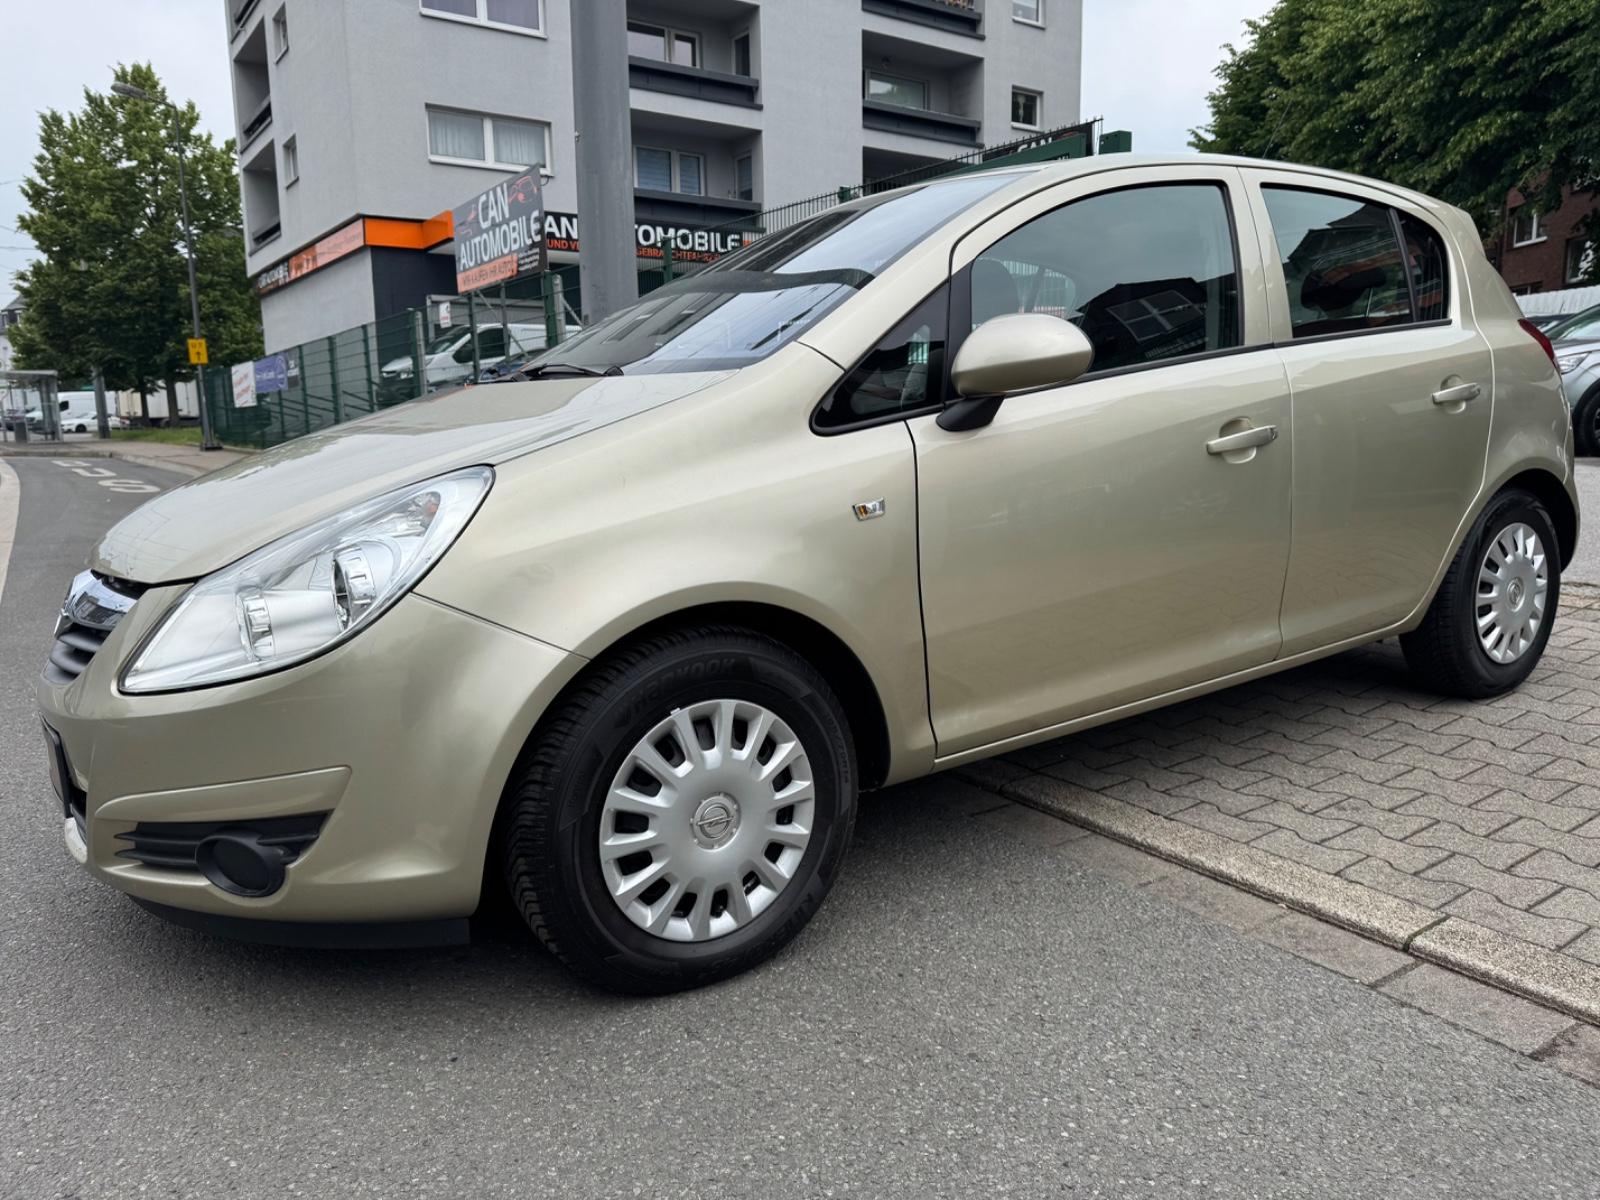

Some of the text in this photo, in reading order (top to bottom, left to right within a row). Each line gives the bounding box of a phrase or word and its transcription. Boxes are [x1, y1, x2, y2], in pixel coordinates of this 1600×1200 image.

[478, 183, 509, 229] CAN
[460, 210, 541, 271] AUTOMOBILE
[545, 214, 740, 253] AN OMOBILE
[548, 239, 569, 249] UND
